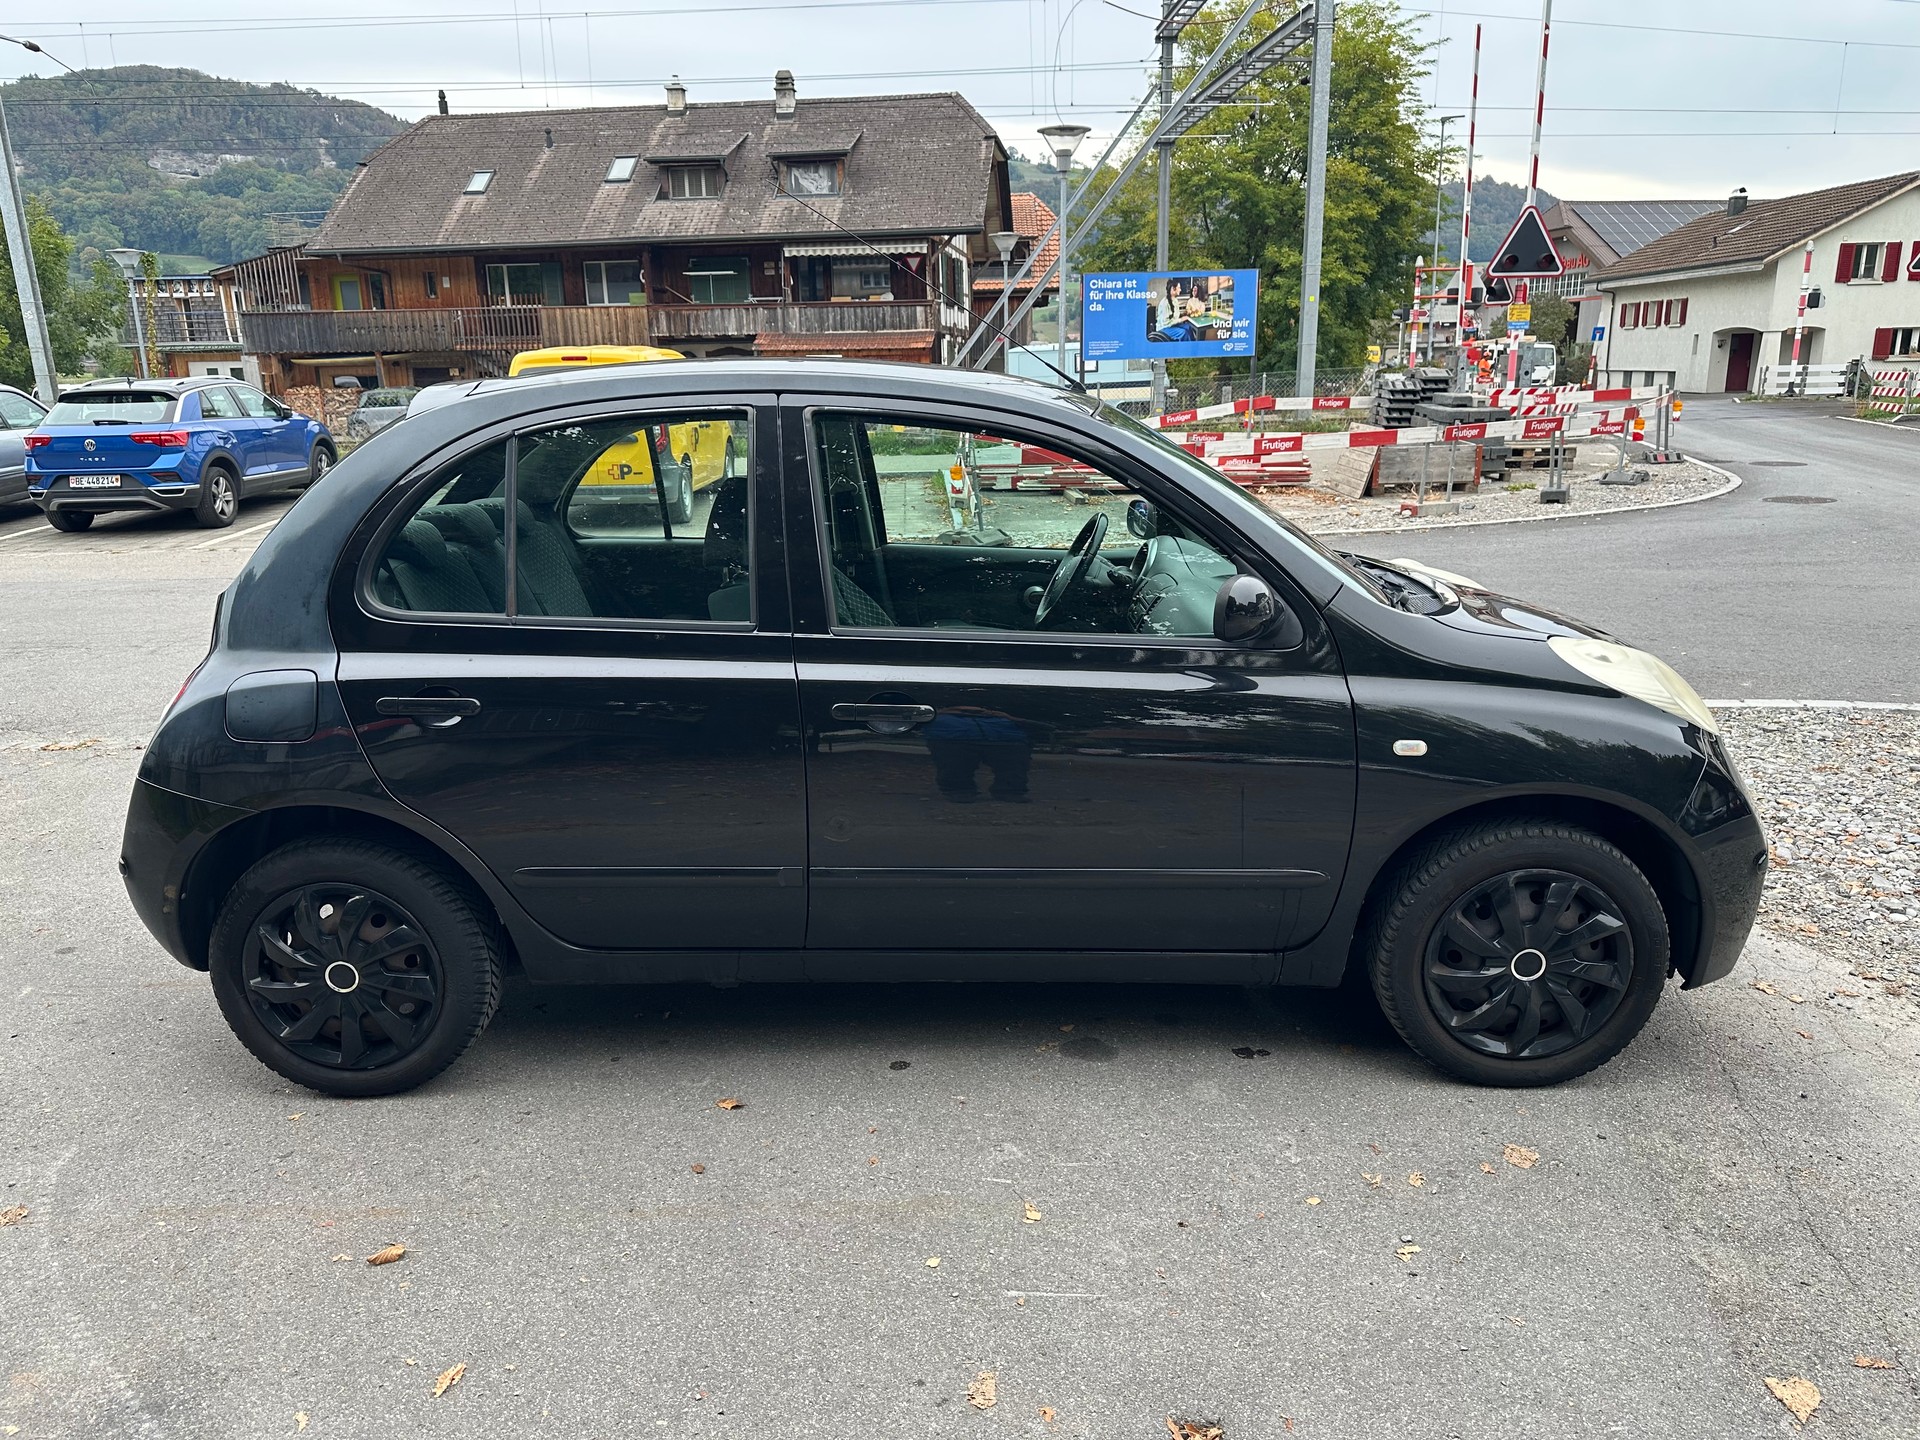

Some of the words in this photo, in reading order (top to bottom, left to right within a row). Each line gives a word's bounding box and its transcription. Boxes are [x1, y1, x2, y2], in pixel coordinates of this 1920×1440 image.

[1089, 278, 1122, 289] Chiara
[1124, 278, 1136, 288] ist
[1089, 290, 1103, 300] für
[1105, 290, 1124, 300] ihre
[1126, 289, 1158, 299] Klasse
[1089, 302, 1105, 312] da.
[1212, 318, 1232, 329] Und
[1234, 318, 1249, 327] wir
[1216, 329, 1231, 340] für
[1232, 329, 1249, 339] sie.
[1318, 398, 1344, 408] Frutiger
[1166, 412, 1192, 424] Frutiger
[1531, 420, 1557, 430] Frutiger
[1192, 434, 1218, 442] Frutiger
[1261, 439, 1294, 451] Frutiger
